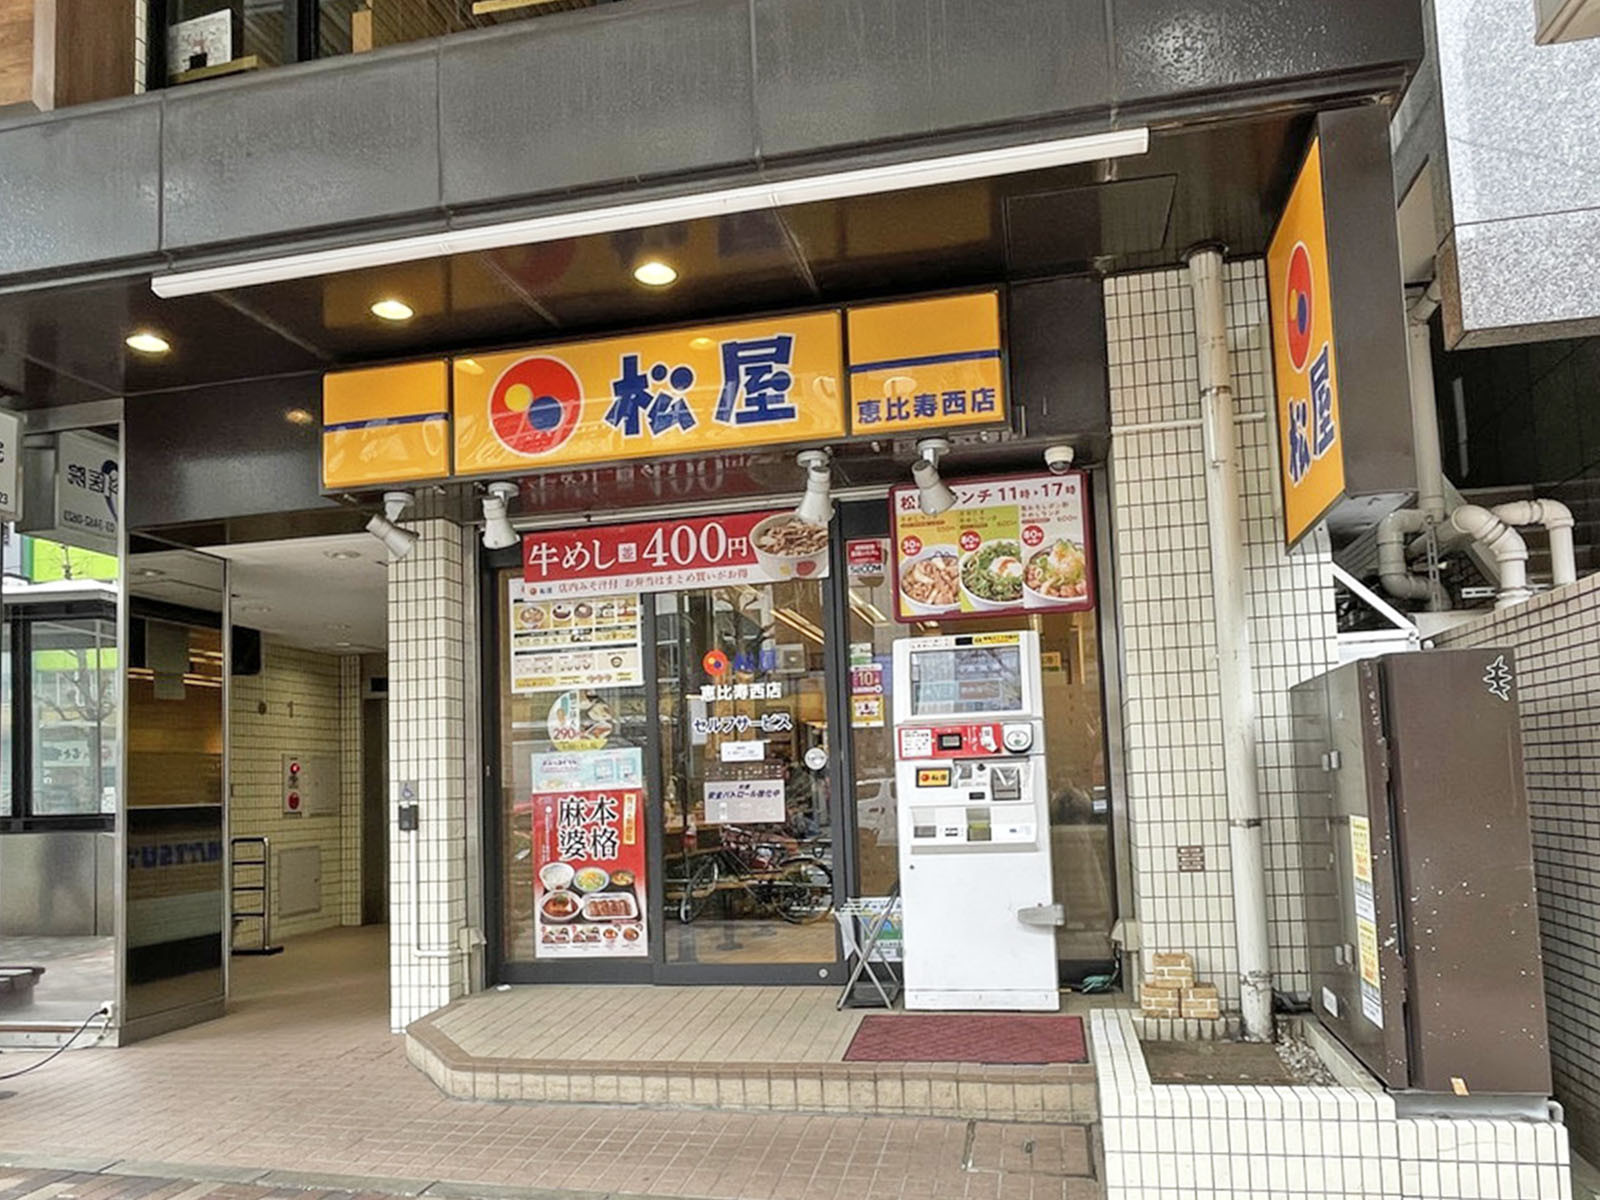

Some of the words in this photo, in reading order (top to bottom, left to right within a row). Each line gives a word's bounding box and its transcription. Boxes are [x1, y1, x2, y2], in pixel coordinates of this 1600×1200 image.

[605, 334, 797, 437] 松屋
[856, 388, 995, 425] 恵比寿西店
[1287, 341, 1335, 488] 松屋
[529, 539, 614, 576] 牛めし
[643, 522, 748, 568] 400円
[700, 682, 782, 701] 恵比寿西店
[694, 713, 793, 734] セルフサービス
[558, 796, 587, 860] 麻婆
[589, 796, 618, 860] 本格
